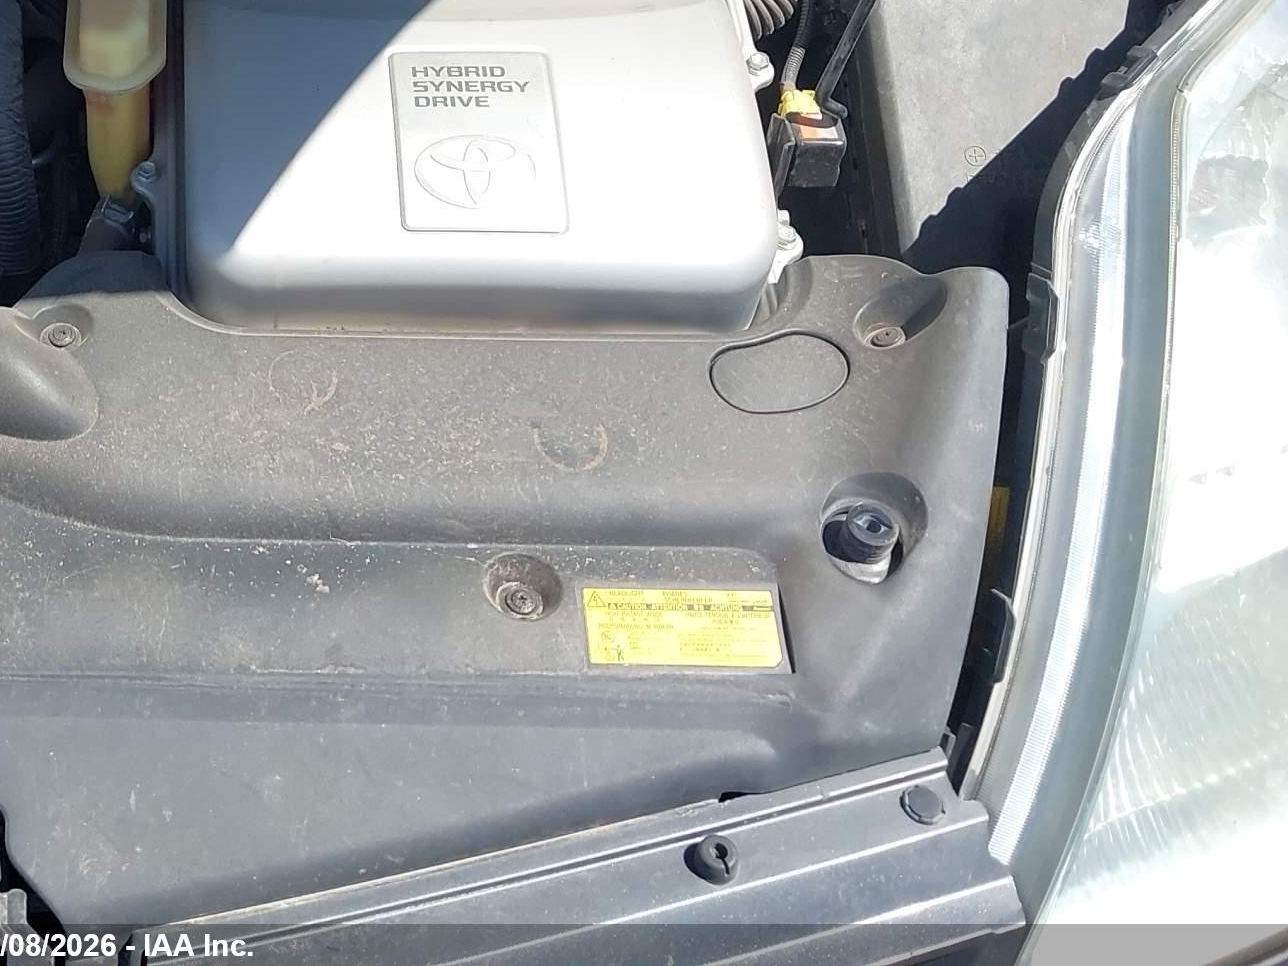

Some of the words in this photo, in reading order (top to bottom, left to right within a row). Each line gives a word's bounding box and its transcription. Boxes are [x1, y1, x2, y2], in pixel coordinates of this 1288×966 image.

[411, 65, 505, 77] HYBRID
[412, 80, 529, 93] SYNERGY
[414, 95, 491, 107] DRIVE
[652, 603, 687, 611] ATTENTION
